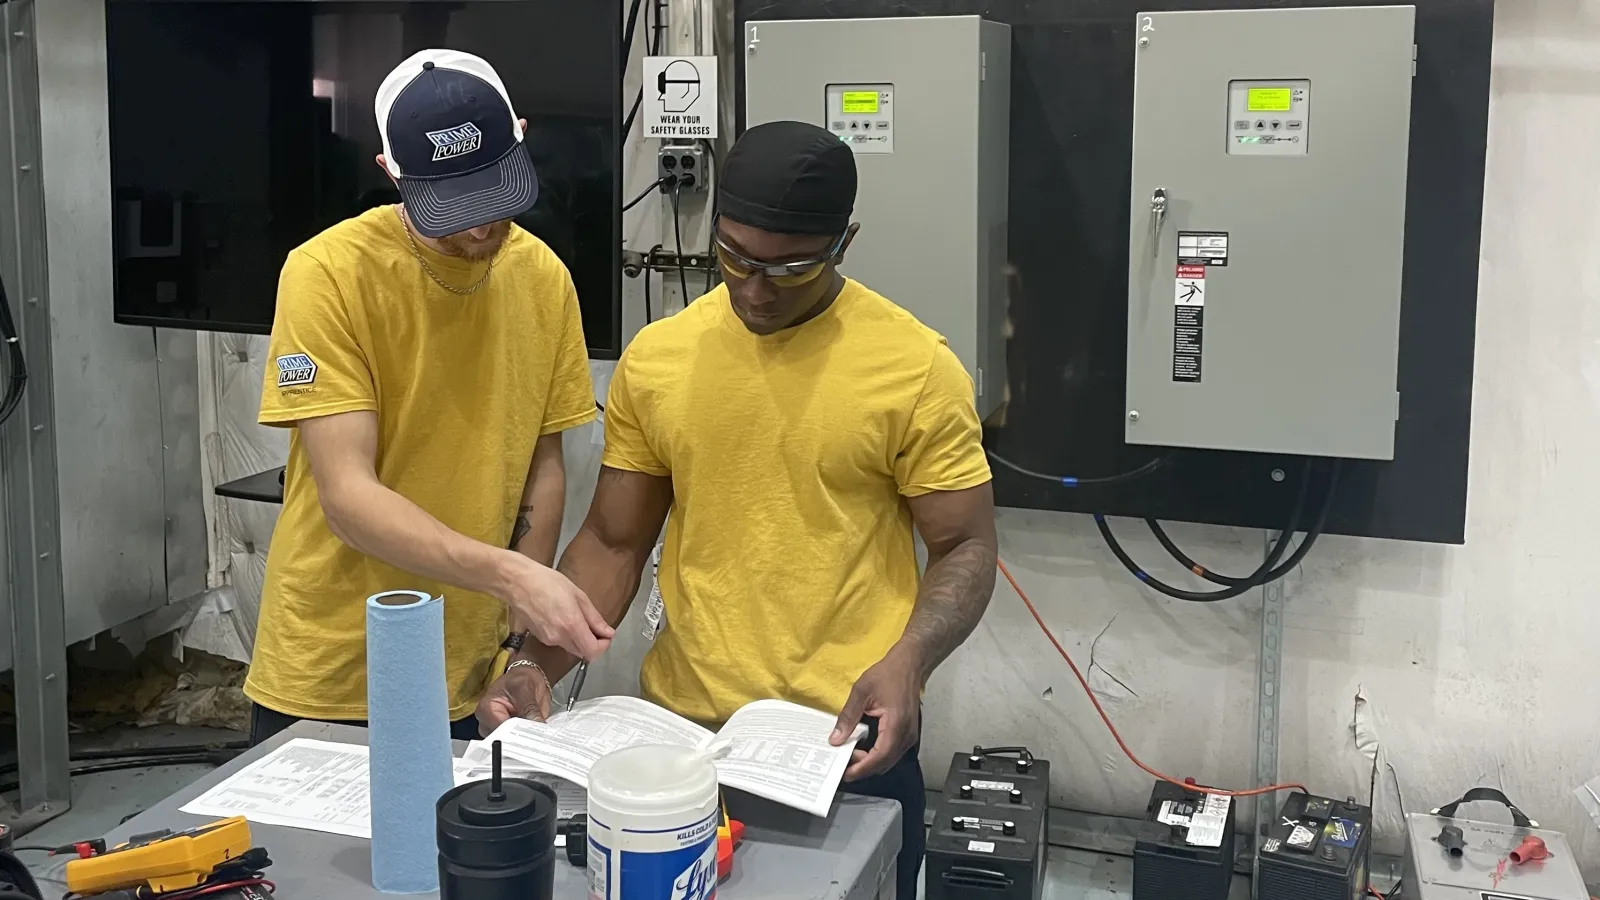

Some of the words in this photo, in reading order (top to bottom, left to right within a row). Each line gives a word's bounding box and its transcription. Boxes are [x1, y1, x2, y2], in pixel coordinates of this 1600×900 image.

[1142, 16, 1155, 32] 2
[750, 26, 760, 43] 1
[660, 115, 680, 124] WEAR
[682, 115, 701, 124] YOUR
[431, 125, 477, 144] PRIME
[650, 126, 677, 135] SAFETY
[679, 126, 710, 135] GLASSES
[436, 136, 477, 158] POWER
[676, 829, 696, 841] KILLS
[696, 822, 709, 835] COLD
